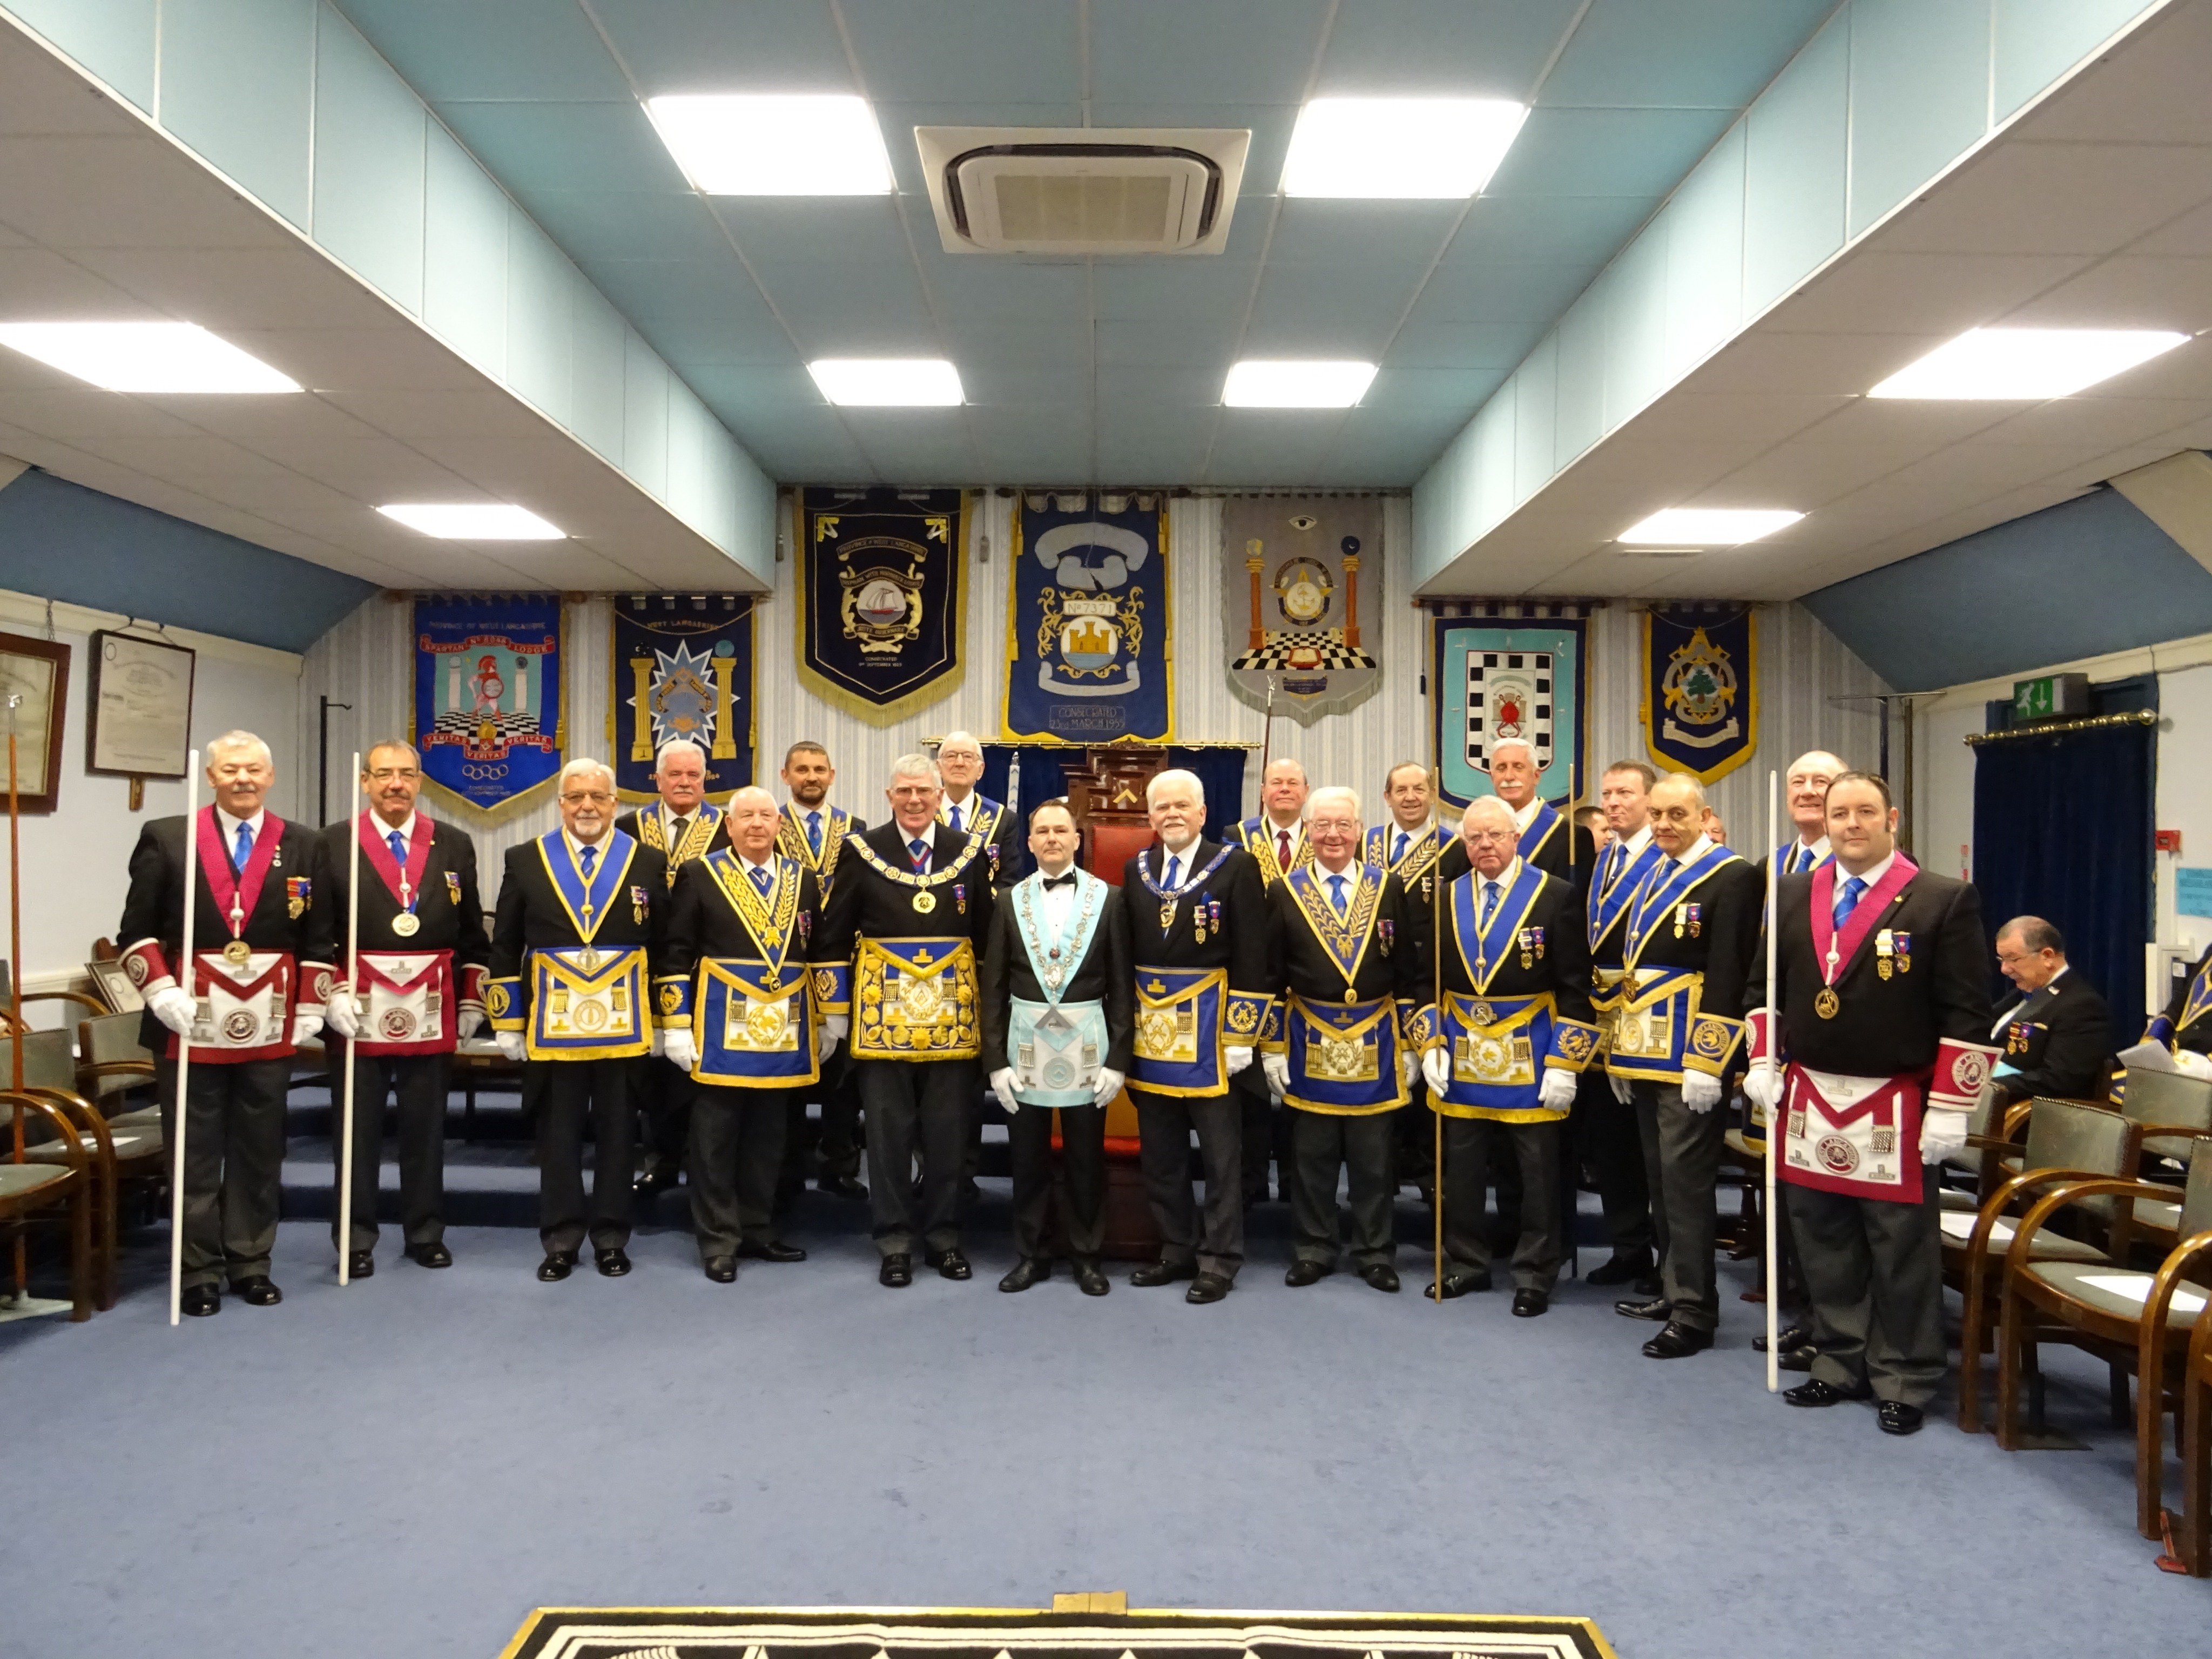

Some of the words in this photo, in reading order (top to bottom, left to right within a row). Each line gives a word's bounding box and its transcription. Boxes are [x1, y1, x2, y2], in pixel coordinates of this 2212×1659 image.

[1083, 603, 1112, 614] 7371
[425, 644, 464, 652] SPARTAN
[514, 645, 547, 653] LODGE
[1059, 707, 1117, 718] CONSECRATED
[1071, 718, 1103, 729] MARCH
[427, 734, 467, 744] VERITAS
[507, 735, 548, 744] VERITAS
[467, 750, 507, 759] VERITAS
